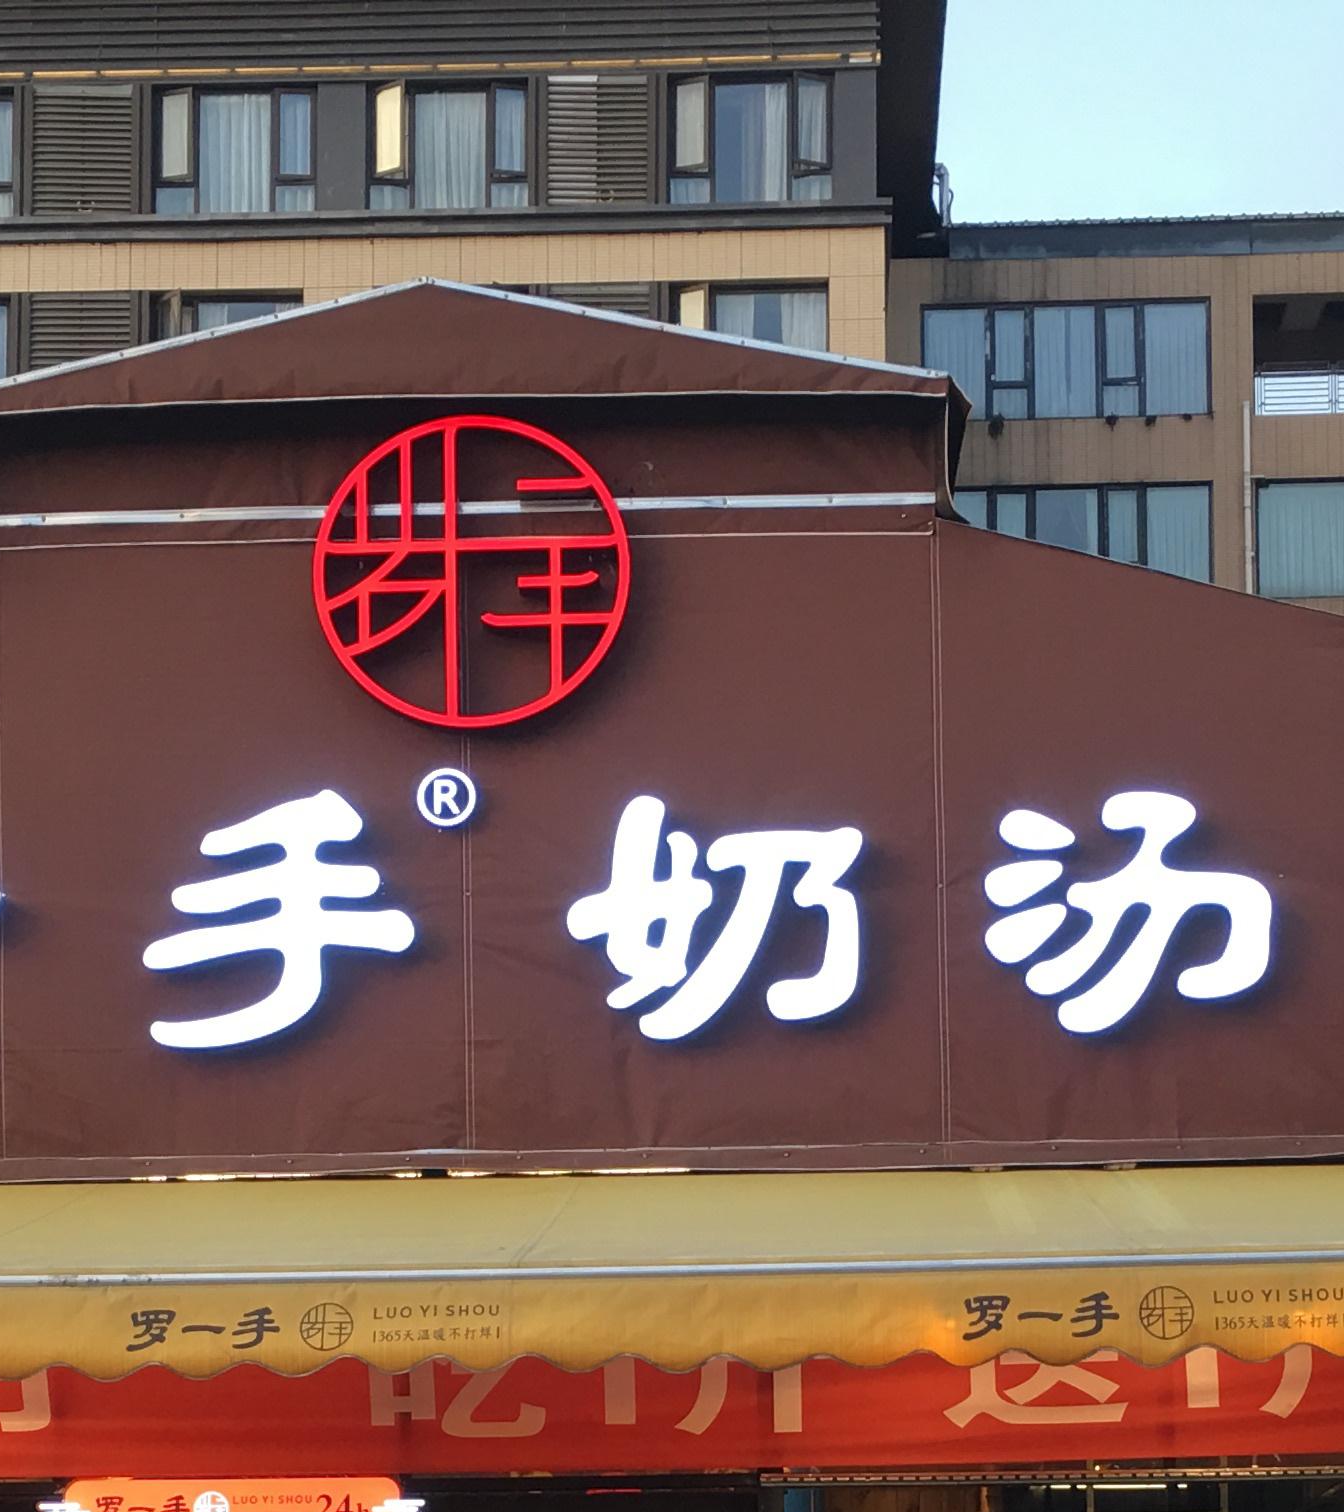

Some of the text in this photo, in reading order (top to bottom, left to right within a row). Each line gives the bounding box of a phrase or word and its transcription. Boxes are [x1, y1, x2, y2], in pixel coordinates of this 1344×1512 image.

[373, 1303, 500, 1320] LUO YI SHOU
[1213, 1289, 1254, 1304] LUO
[1261, 1288, 1282, 1302] YI
[126, 1306, 280, 1352] 罗一手
[962, 1290, 1120, 1341] 罗一手
